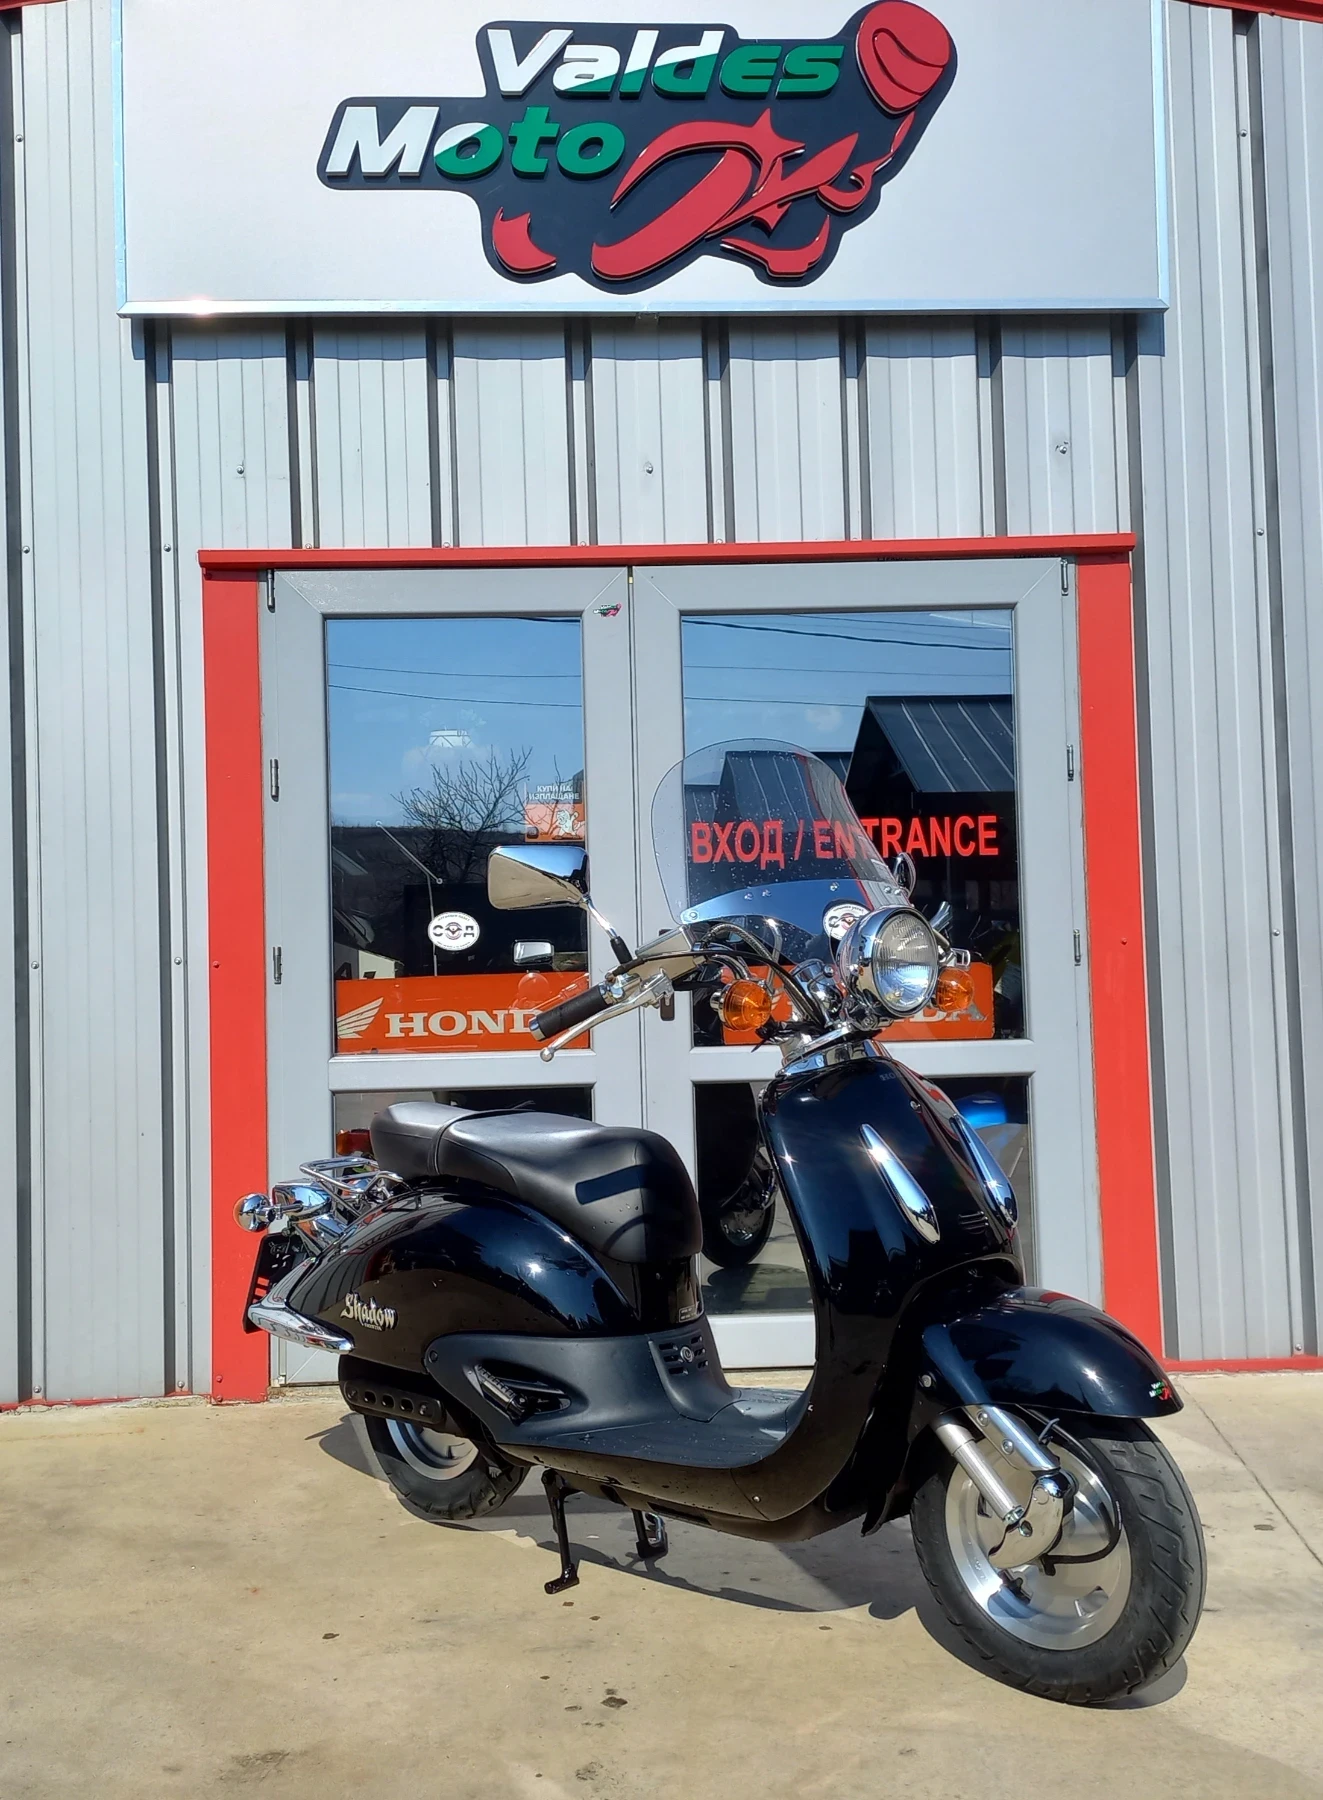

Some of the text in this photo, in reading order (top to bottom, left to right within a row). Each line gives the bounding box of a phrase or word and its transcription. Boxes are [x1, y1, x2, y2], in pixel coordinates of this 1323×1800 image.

[486, 29, 844, 96] Valdes
[325, 105, 626, 177] Moto
[536, 785, 558, 793] КУПИ
[691, 820, 786, 870] ВХОД
[814, 815, 999, 860] ENTRANCE
[384, 1009, 543, 1038] HOND
[340, 1292, 396, 1329] Shadow
